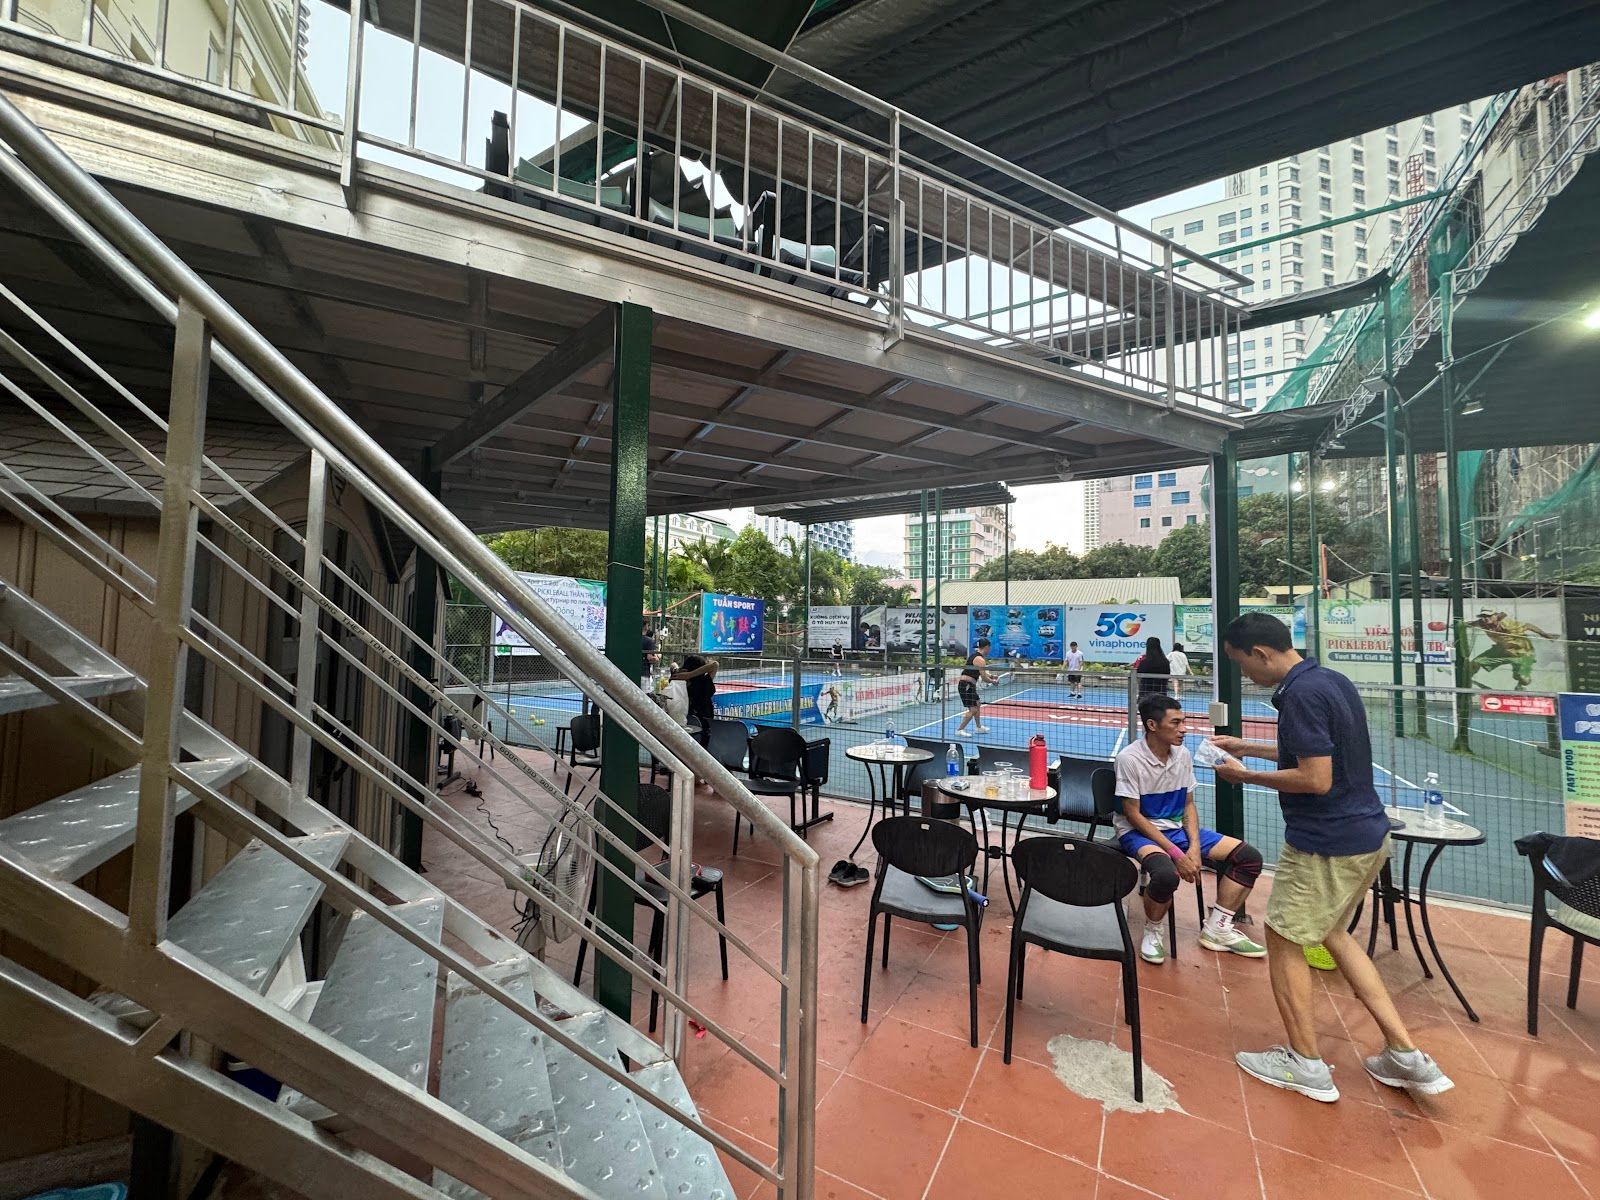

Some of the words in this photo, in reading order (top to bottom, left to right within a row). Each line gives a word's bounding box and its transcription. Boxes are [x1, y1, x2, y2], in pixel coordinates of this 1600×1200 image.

[733, 601, 756, 610] SPORT
[284, 569, 305, 587] GIA
[317, 597, 337, 615] ONG
[341, 616, 364, 637] THEP
[388, 654, 401, 666] MA
[1089, 638, 1147, 649] vinaphone
[1565, 749, 1574, 771] FOOD
[1566, 772, 1576, 792] FAST
